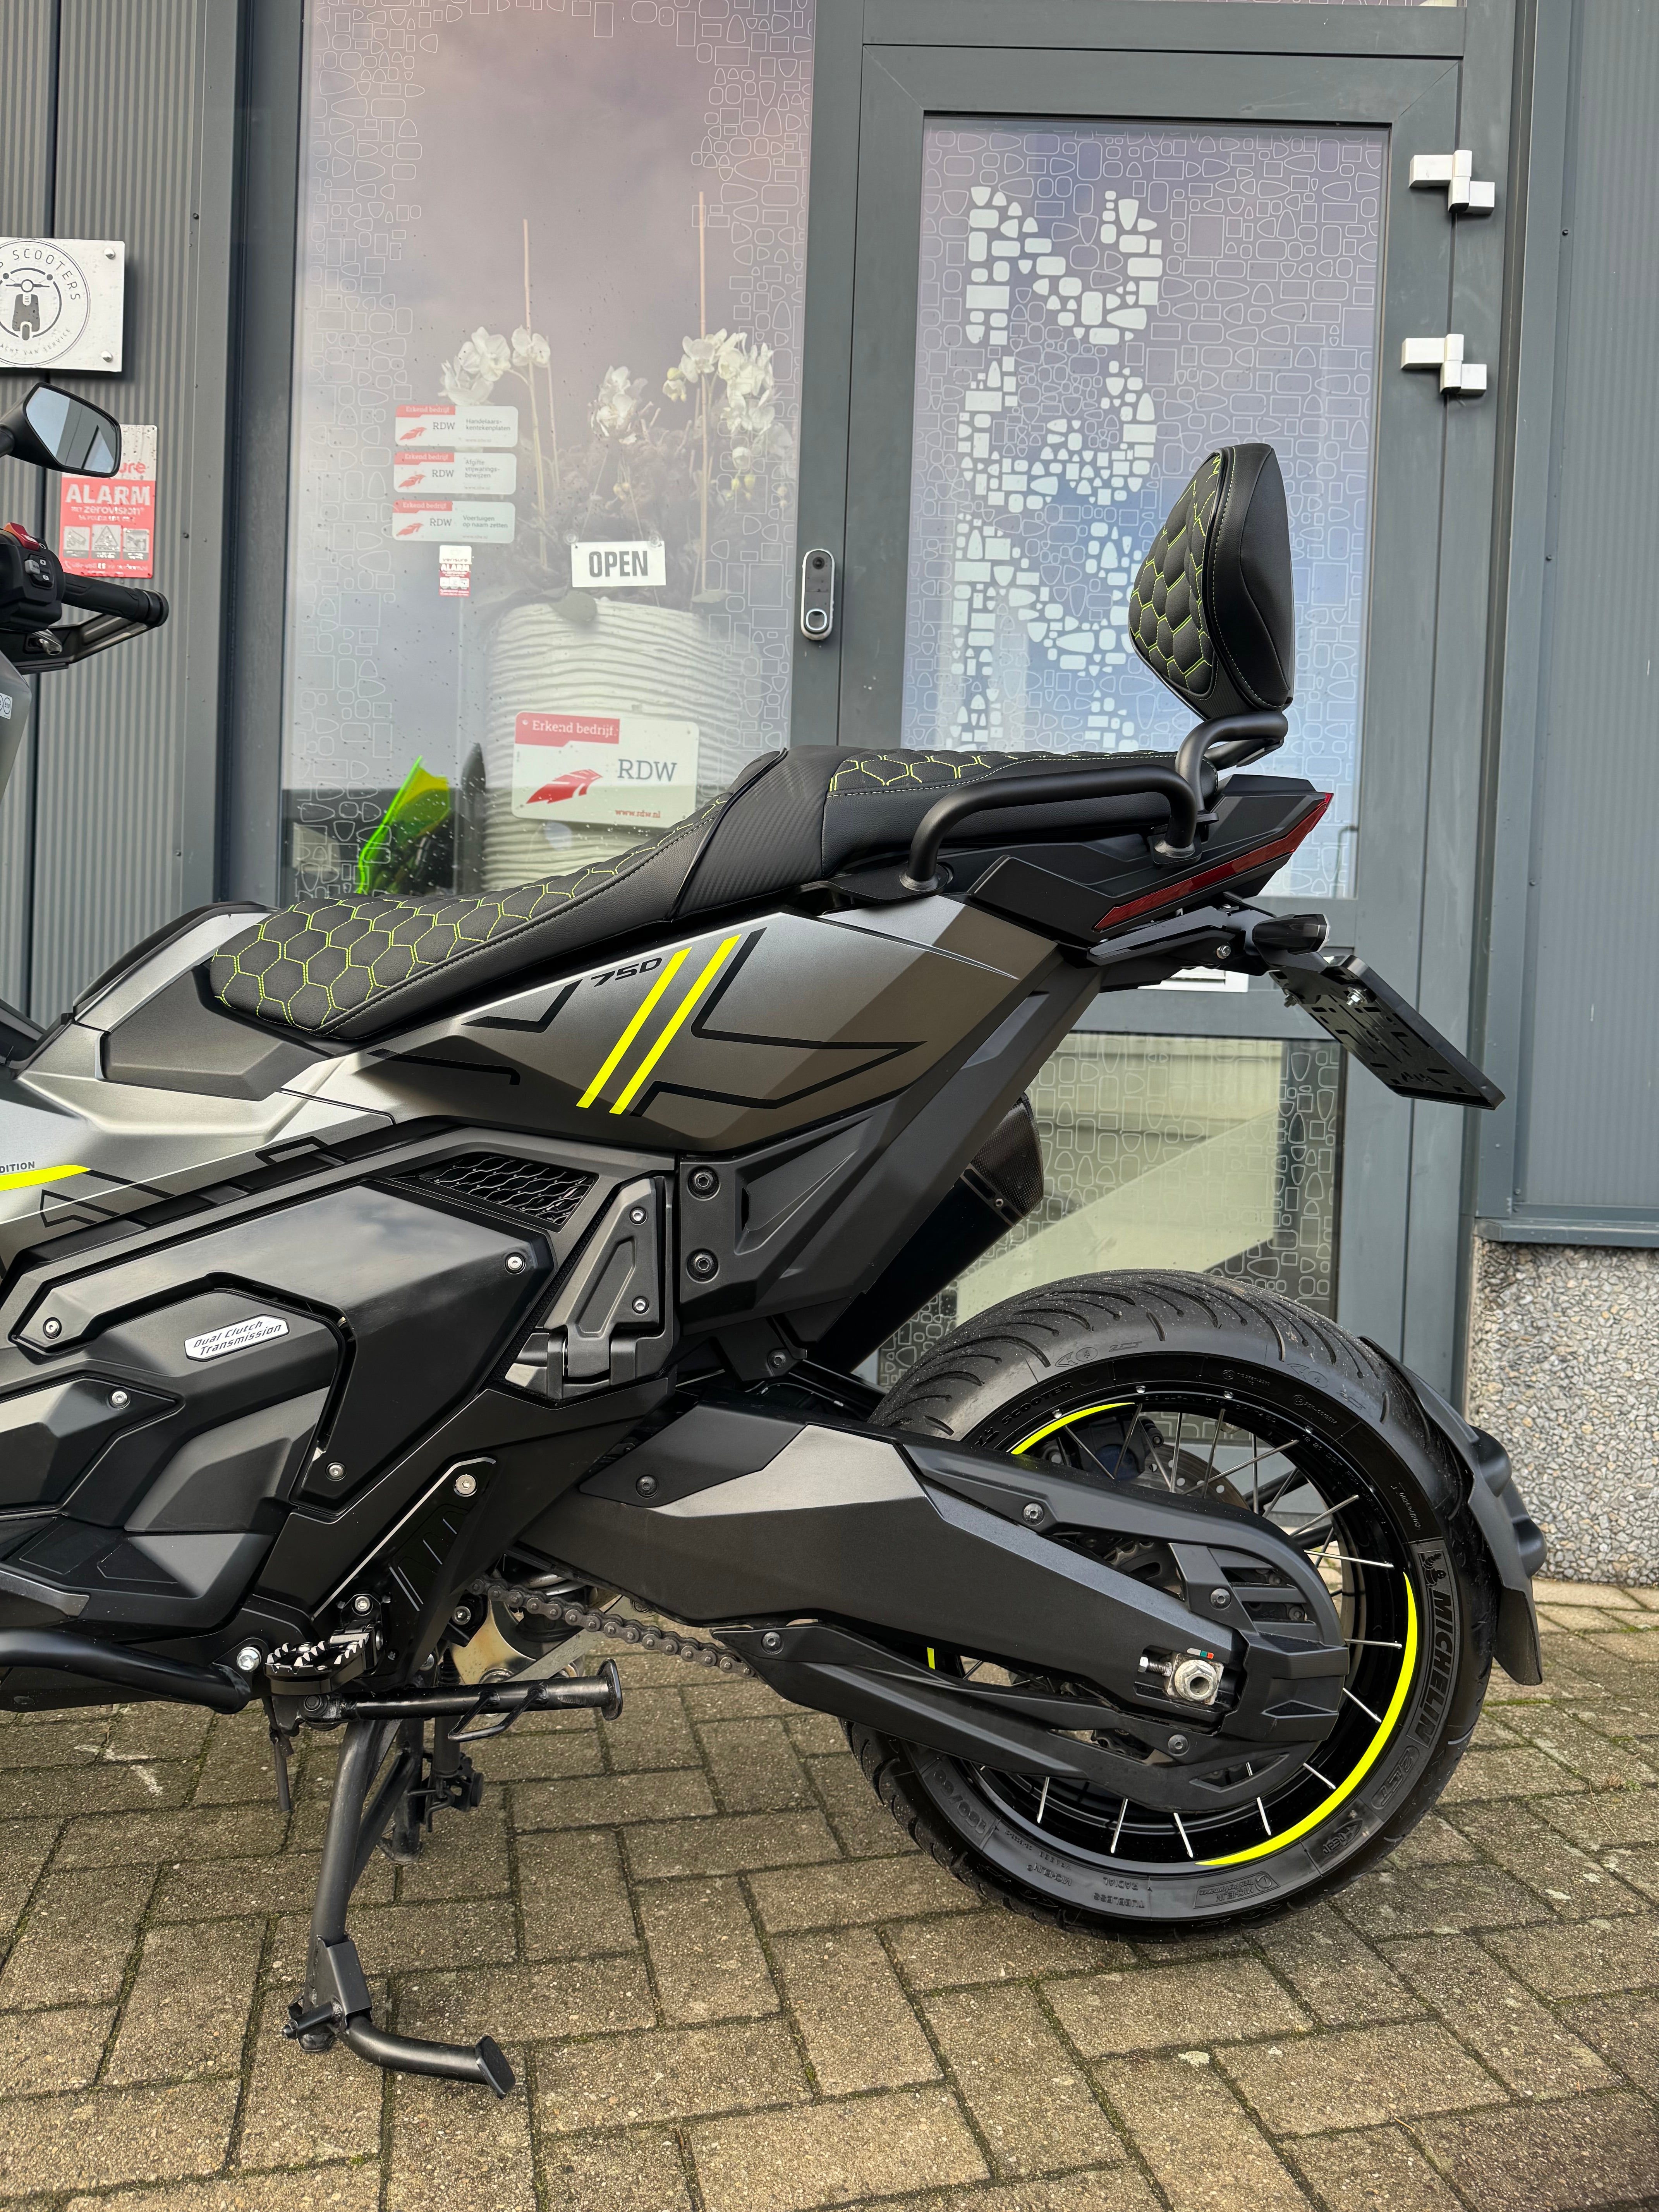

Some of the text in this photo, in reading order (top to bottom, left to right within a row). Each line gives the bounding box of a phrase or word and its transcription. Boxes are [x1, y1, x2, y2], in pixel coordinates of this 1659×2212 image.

[13, 249, 81, 300] SCOOTERS
[433, 422, 455, 430] RDW
[65, 484, 150, 506] ALARM
[429, 518, 452, 526] RDW
[441, 563, 470, 572] ALARM
[589, 551, 648, 577] OPEN
[532, 720, 613, 738] Erkend bedrijf
[617, 759, 677, 782] RDW
[615, 809, 661, 819] www.rdw.nl
[193, 1321, 263, 1348] Dual Clutch
[200, 1324, 282, 1355] Transmission
[1001, 1382, 1073, 1425] SCOOTER
[1415, 1589, 1453, 1747] MICHELIN
[1380, 1750, 1413, 1807] 2CT
[933, 1769, 986, 1834] 160/60
[1103, 1877, 1139, 1891] RADIAL
[1216, 1886, 1254, 1903] MICHELIN
[1094, 1892, 1145, 1908] TUBELESS
